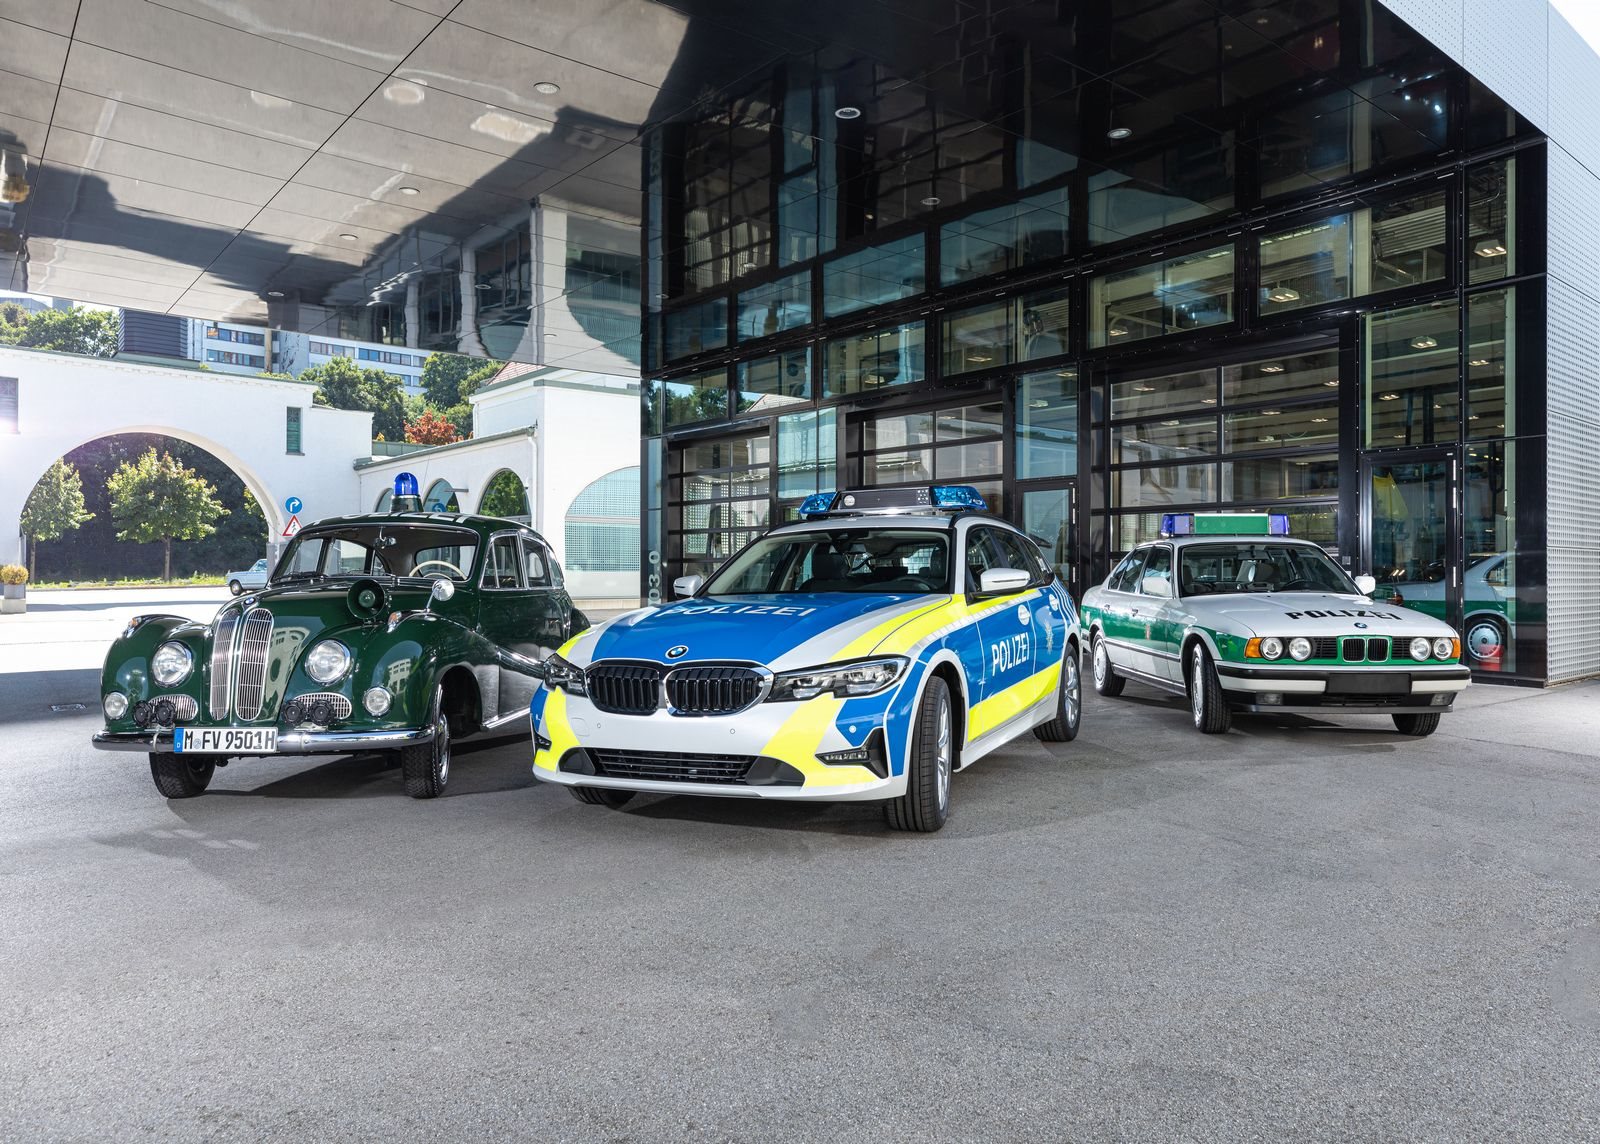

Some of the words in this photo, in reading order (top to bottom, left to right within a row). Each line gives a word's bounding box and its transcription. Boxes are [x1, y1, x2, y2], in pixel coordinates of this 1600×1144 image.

[654, 605, 817, 618] POLIZEI
[1284, 609, 1403, 621] POLIZEI
[991, 631, 1030, 677] POLIZEI
[184, 731, 194, 750] M
[202, 731, 222, 750] FV
